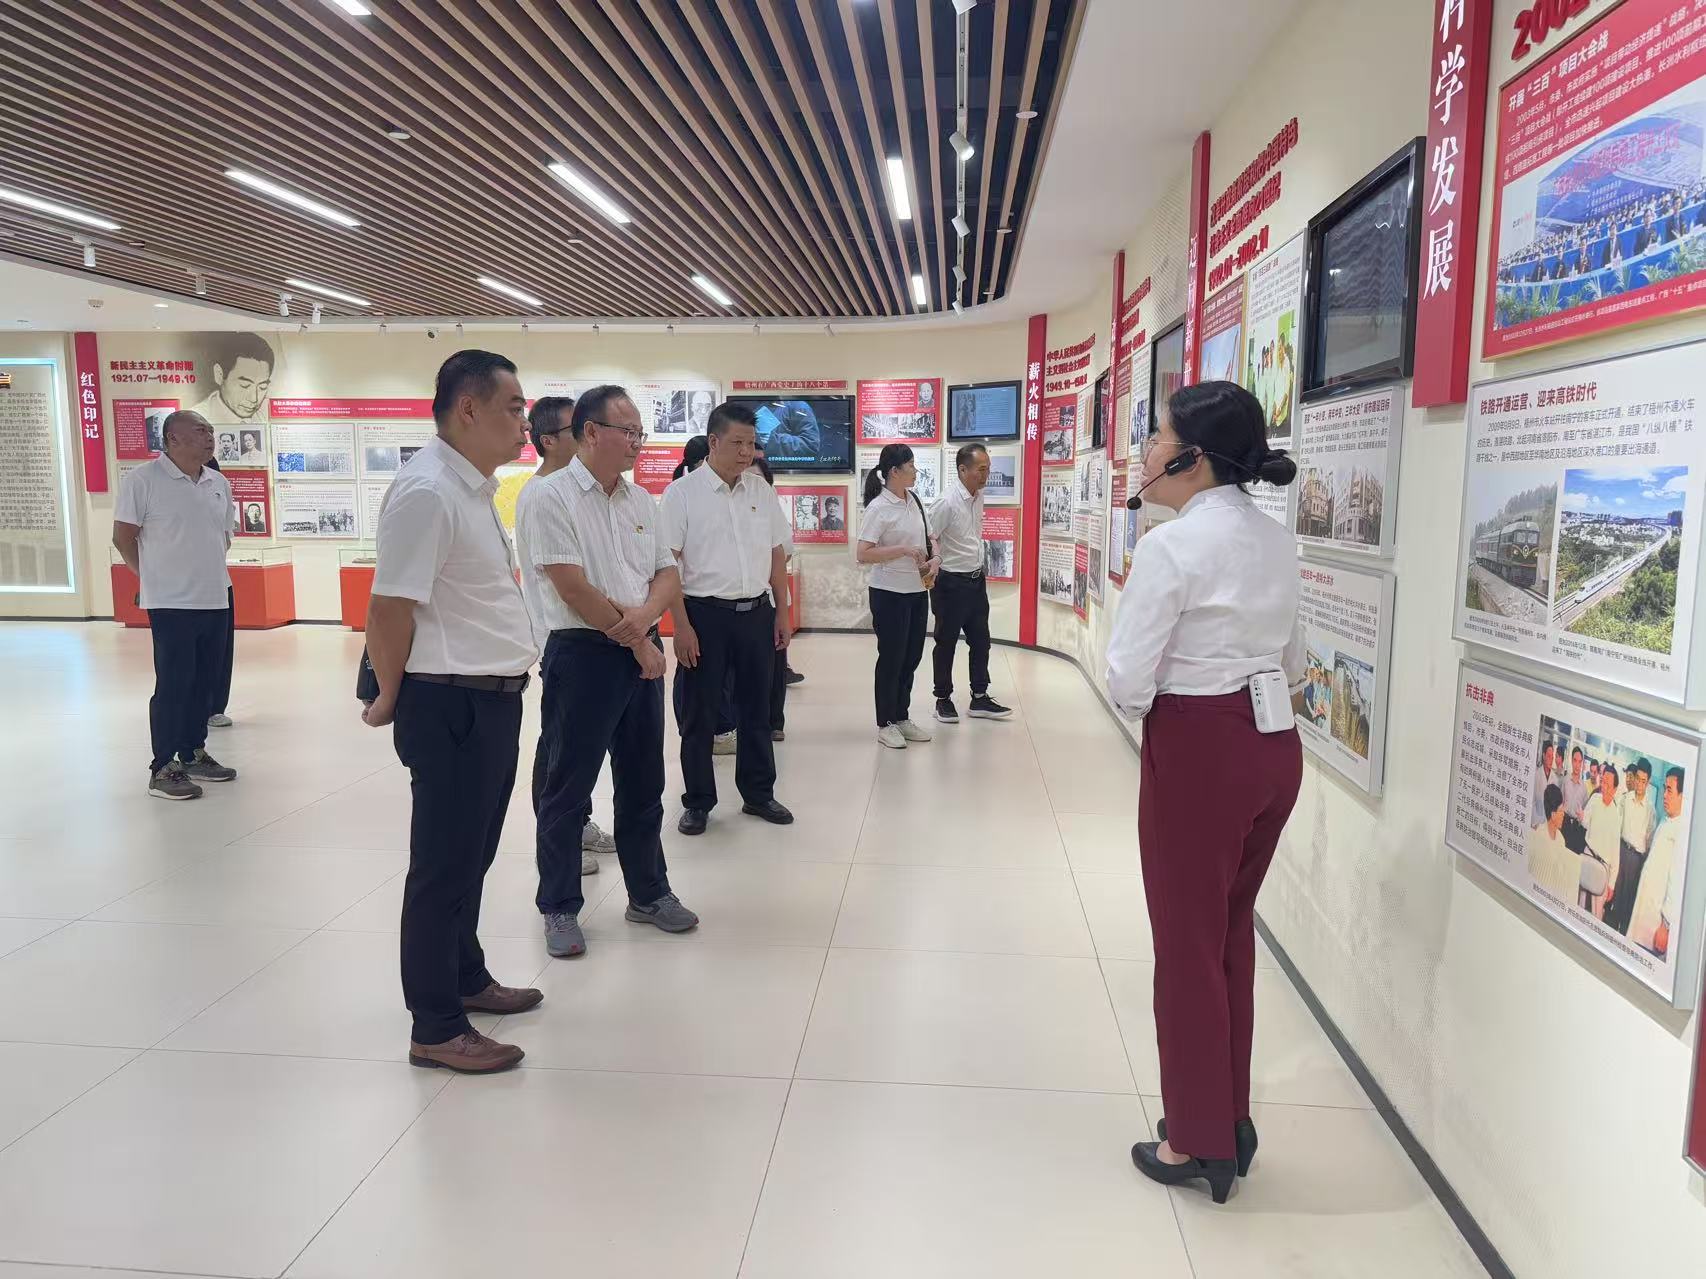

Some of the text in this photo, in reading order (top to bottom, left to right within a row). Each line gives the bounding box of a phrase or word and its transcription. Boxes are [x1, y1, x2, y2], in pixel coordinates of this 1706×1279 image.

[110, 361, 194, 370] 新民主主义革命时期
[80, 372, 99, 439] 红色印记
[1027, 362, 1040, 440] 薪火相传
[1480, 382, 1597, 416] 铁路开通运营、迎来高铁时代
[1465, 682, 1494, 706] 抗击非典
